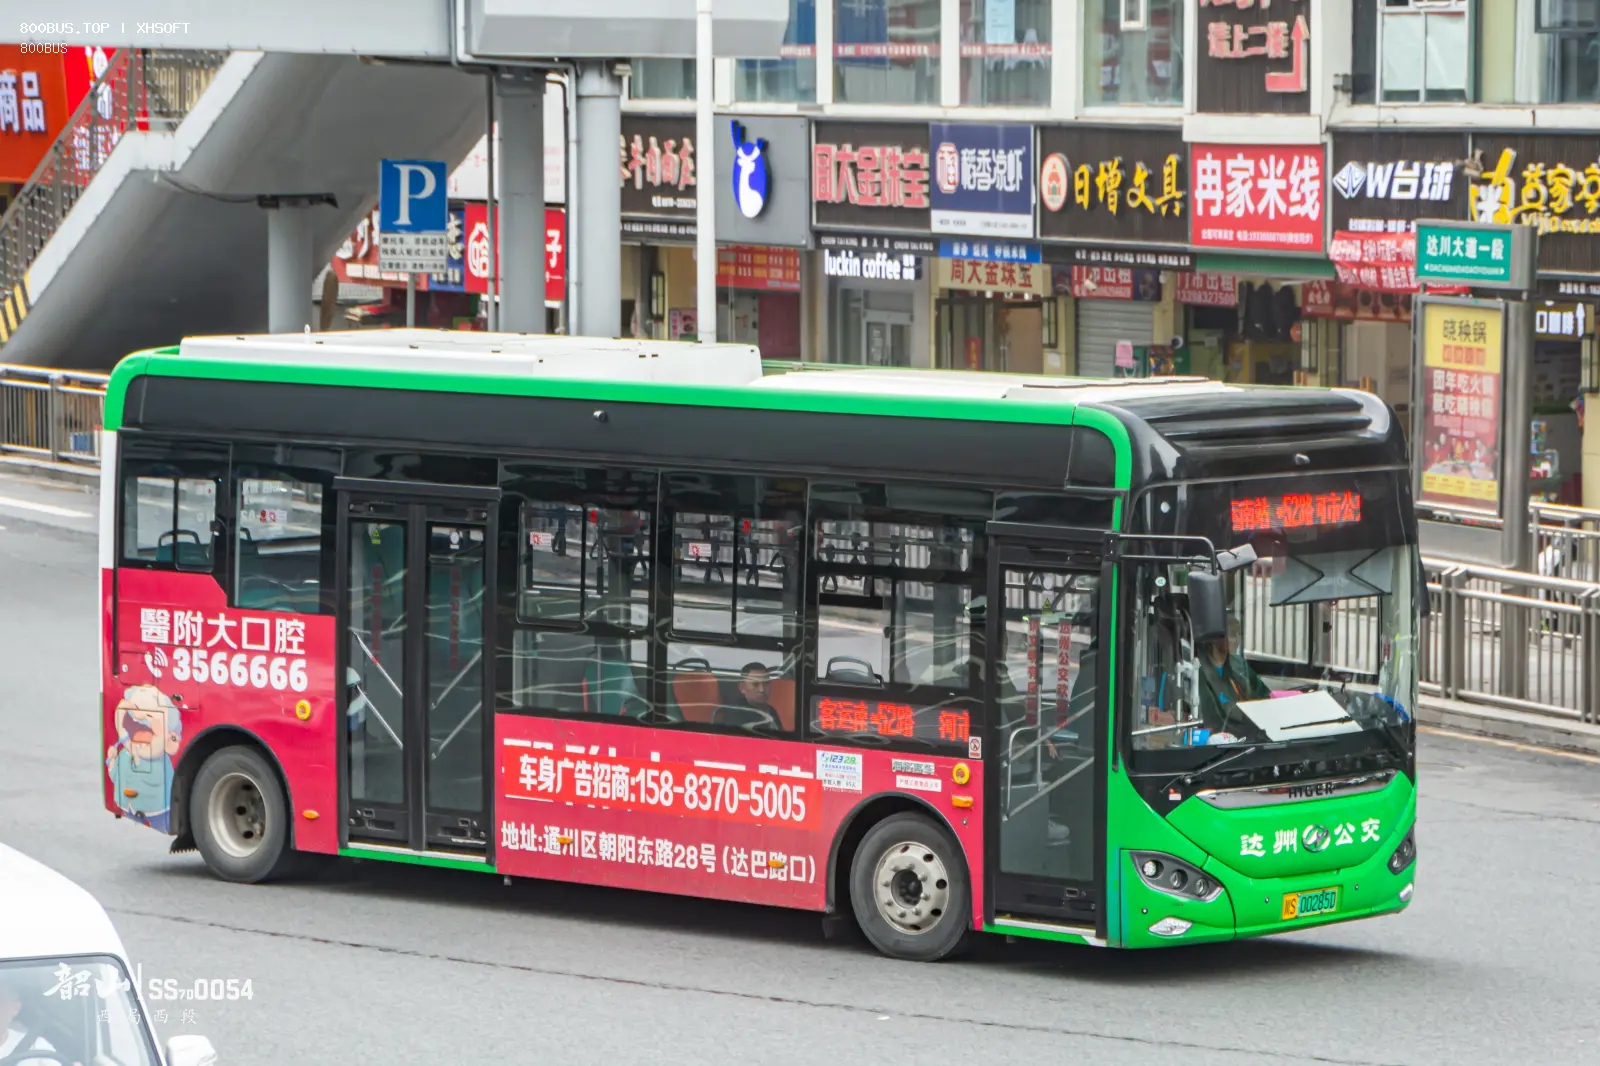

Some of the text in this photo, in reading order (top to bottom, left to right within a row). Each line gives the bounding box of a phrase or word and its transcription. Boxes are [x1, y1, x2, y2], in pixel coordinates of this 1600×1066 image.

[392, 164, 436, 225] P
[813, 144, 929, 208] 周大金珠宝
[1074, 154, 1184, 217] 日增文具
[1195, 152, 1320, 221] 冉家米线
[824, 249, 860, 277] luckin
[862, 253, 901, 280] coffee
[1426, 235, 1504, 261] 达川大道一段
[140, 608, 306, 655] 醫附大口腔
[172, 648, 308, 692] 3566666
[519, 754, 807, 822] 车身广告招商:158-8370-5005
[1288, 782, 1335, 799] HIGER
[1240, 818, 1381, 857] 达州 公交
